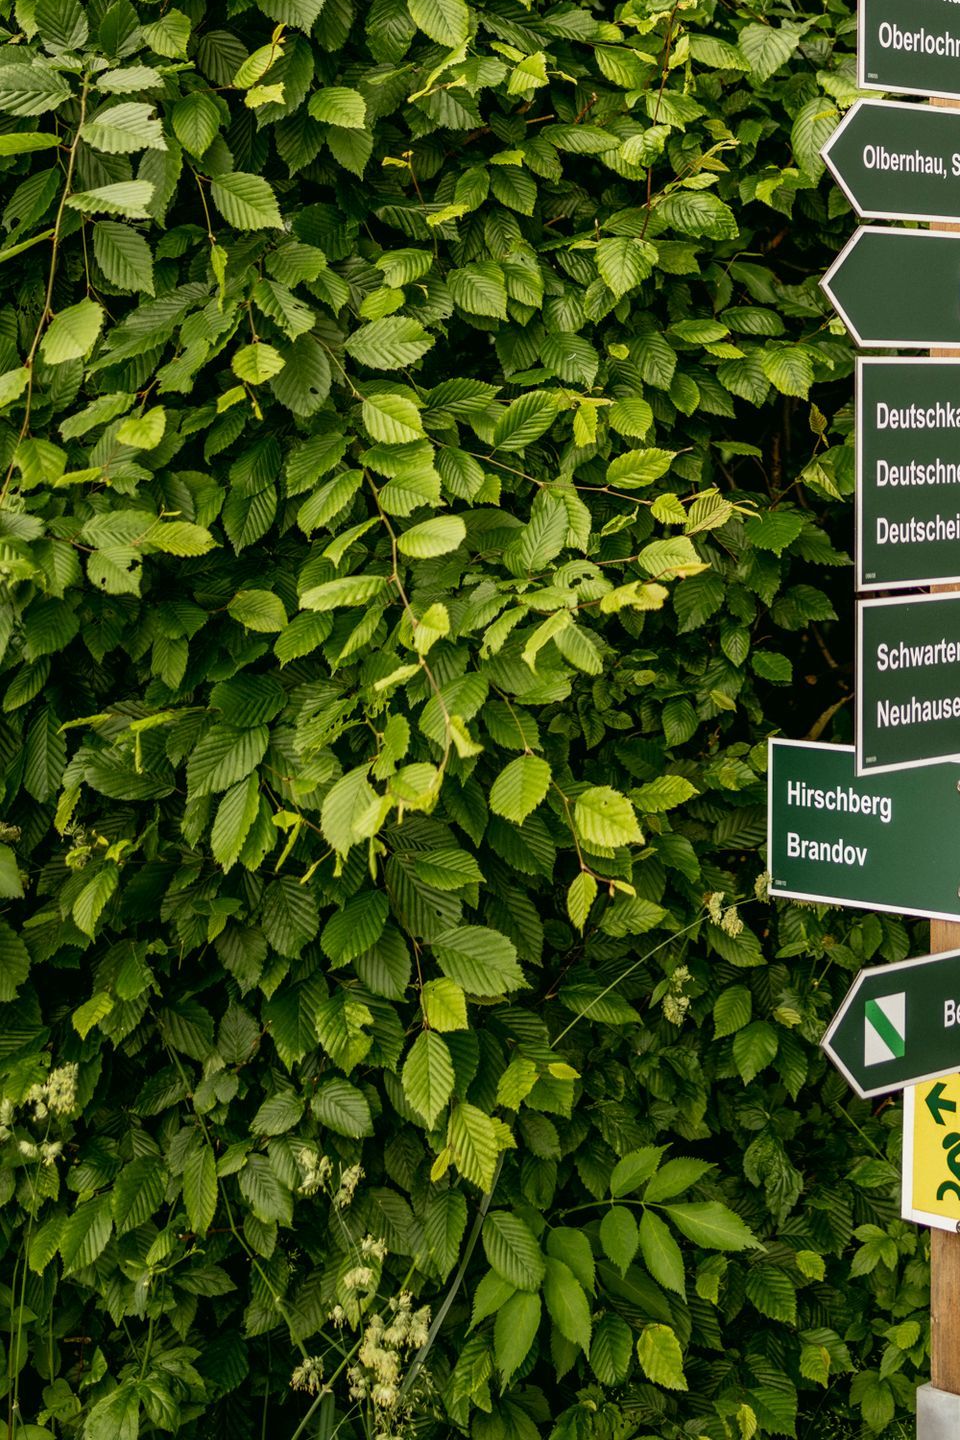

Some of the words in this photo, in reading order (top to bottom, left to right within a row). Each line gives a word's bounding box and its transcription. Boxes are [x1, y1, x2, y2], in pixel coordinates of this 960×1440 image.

[863, 145, 947, 178] Olbernhau,
[787, 781, 892, 824] Hirschberg
[787, 832, 867, 867] Brandov
